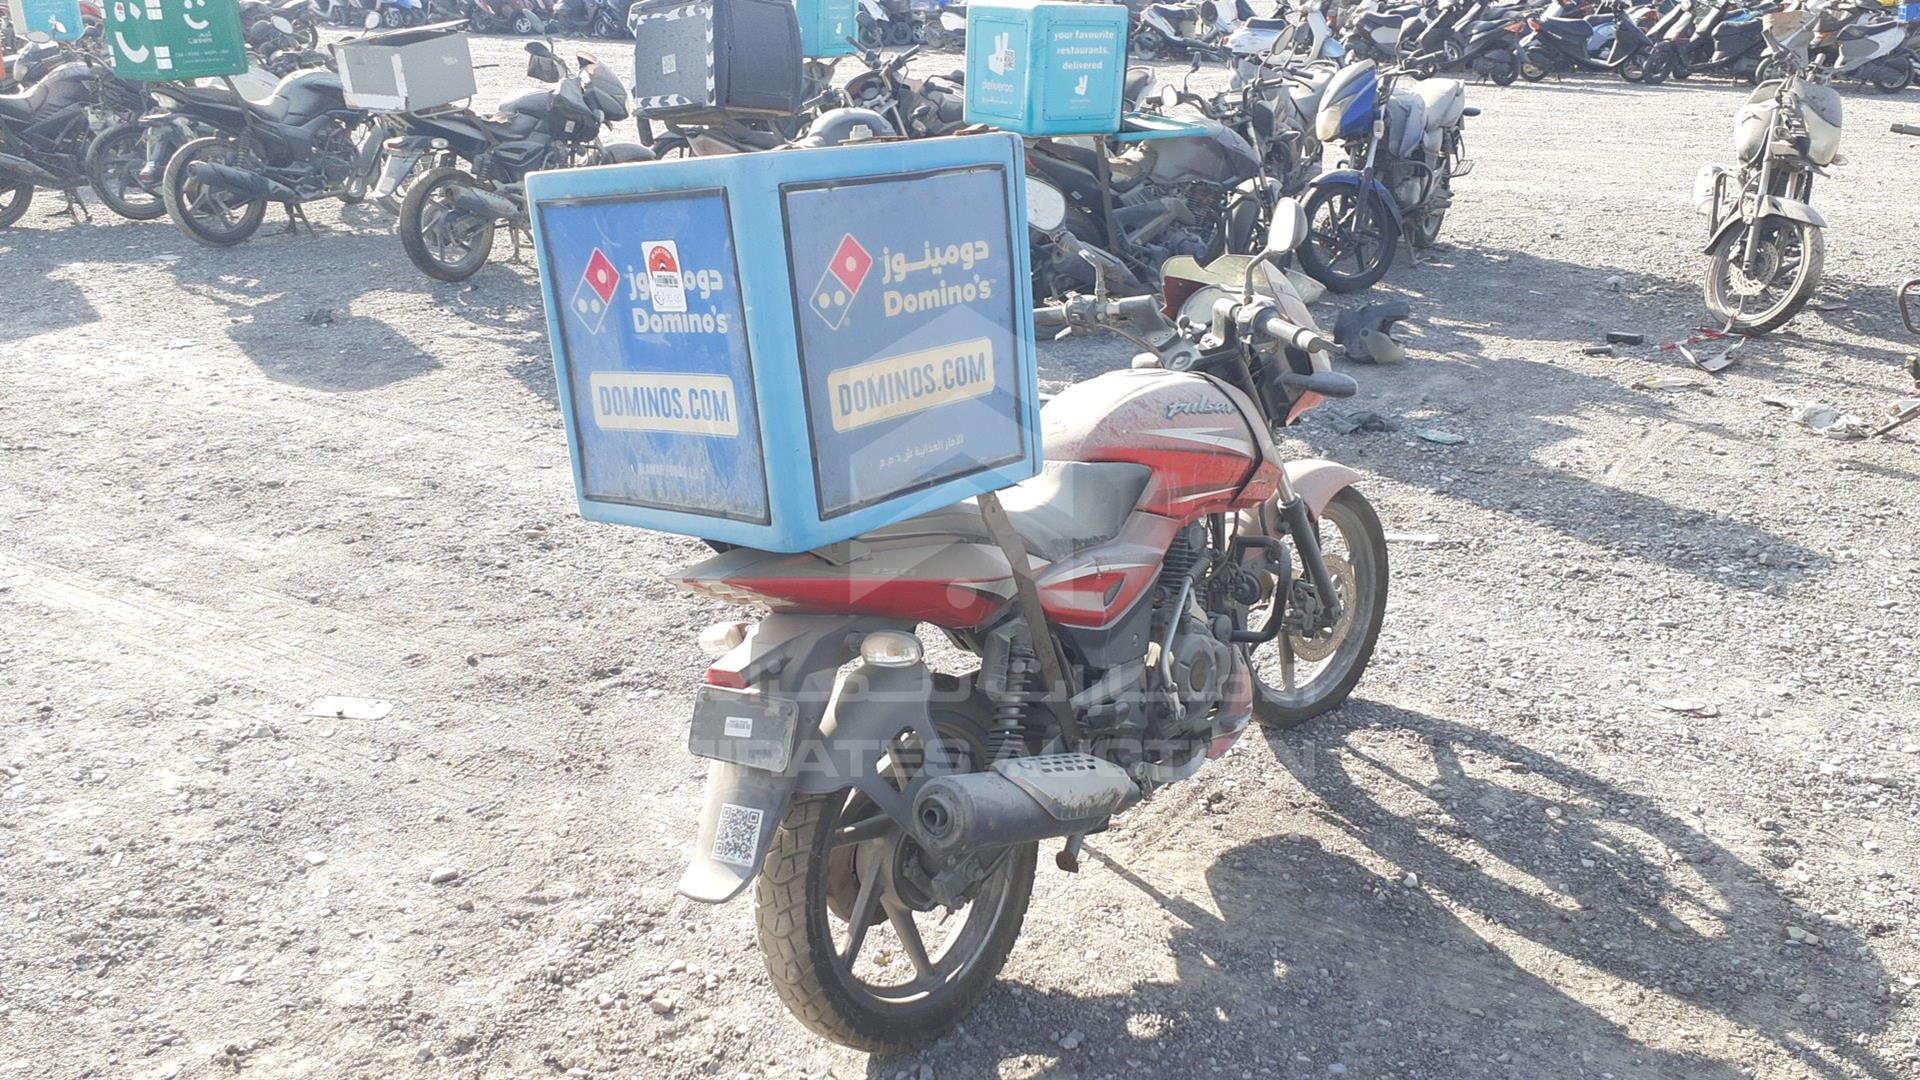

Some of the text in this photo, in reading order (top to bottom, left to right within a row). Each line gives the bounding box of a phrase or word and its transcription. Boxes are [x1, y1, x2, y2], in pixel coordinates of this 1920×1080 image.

[1054, 29, 1114, 41] your favourite
[1062, 60, 1103, 71] delivered
[883, 274, 991, 318] Domino's
[632, 305, 728, 334] Domino's
[838, 352, 987, 418] DOMINOS.COM
[599, 386, 731, 423] DOMINOS.COM
